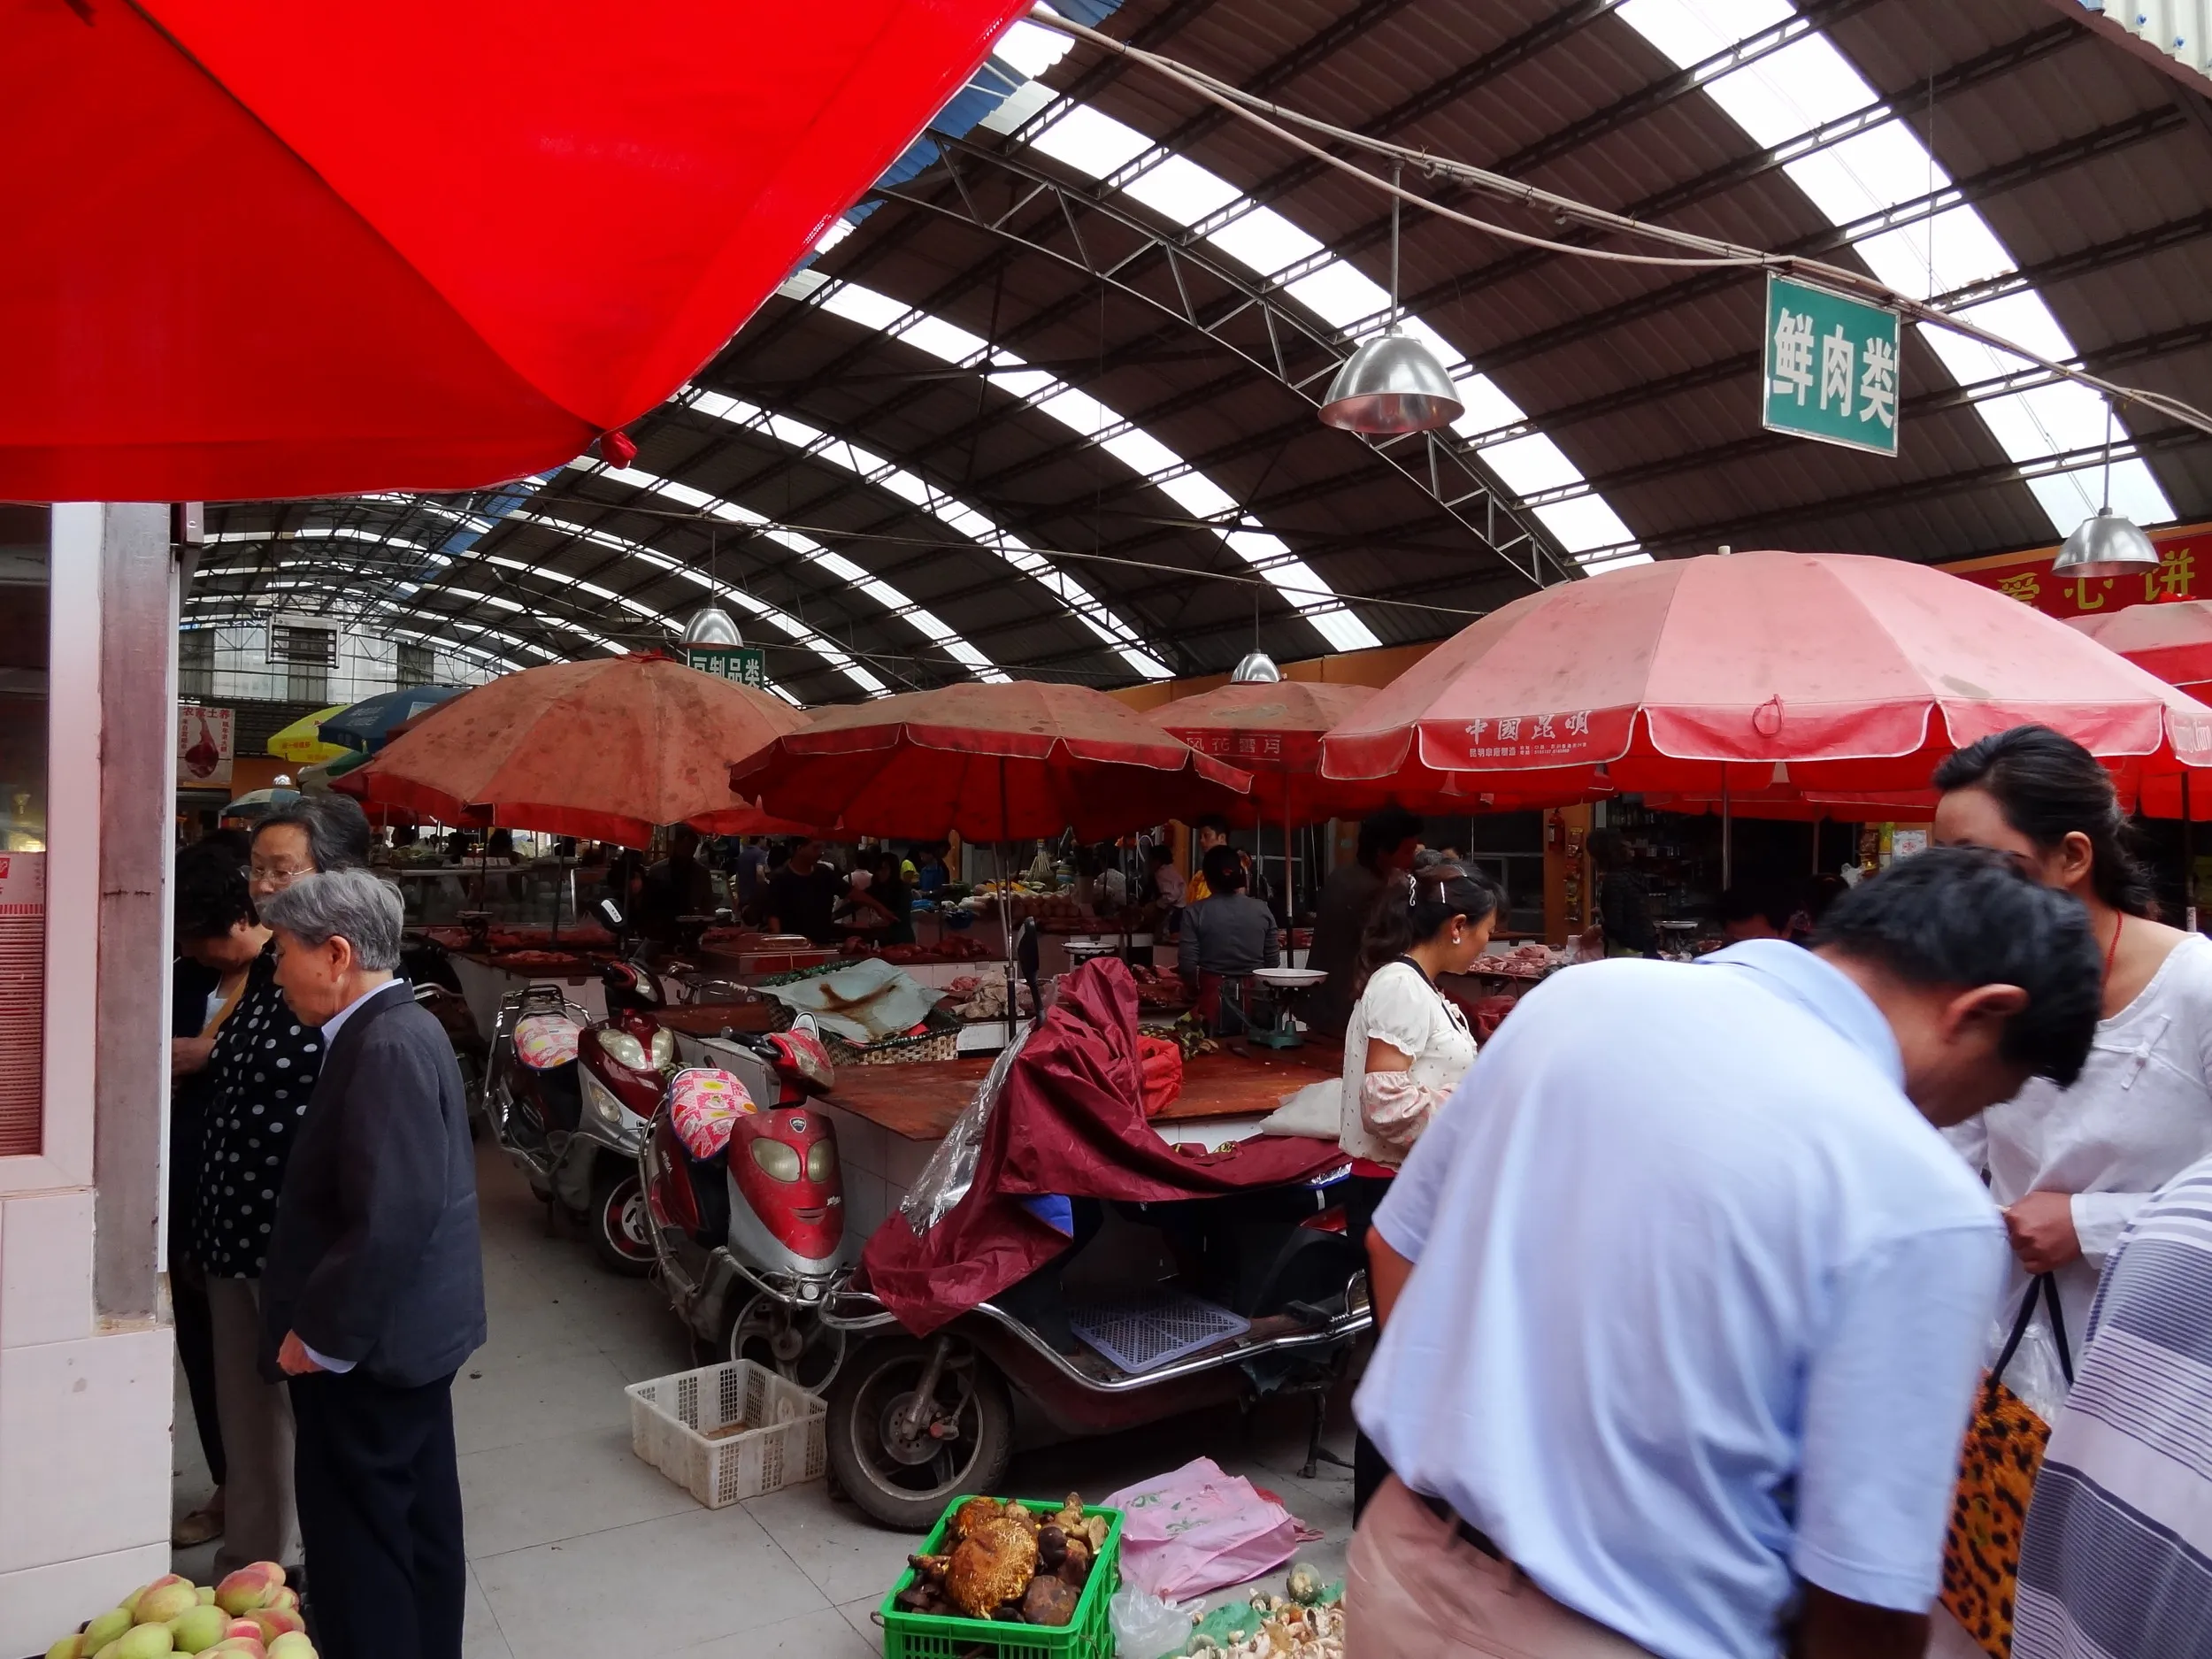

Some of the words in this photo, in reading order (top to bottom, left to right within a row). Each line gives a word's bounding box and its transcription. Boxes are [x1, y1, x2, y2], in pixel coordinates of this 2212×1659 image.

[1774, 308, 1893, 428] 鲜肉类
[1465, 710, 1592, 745] 中國昆明
